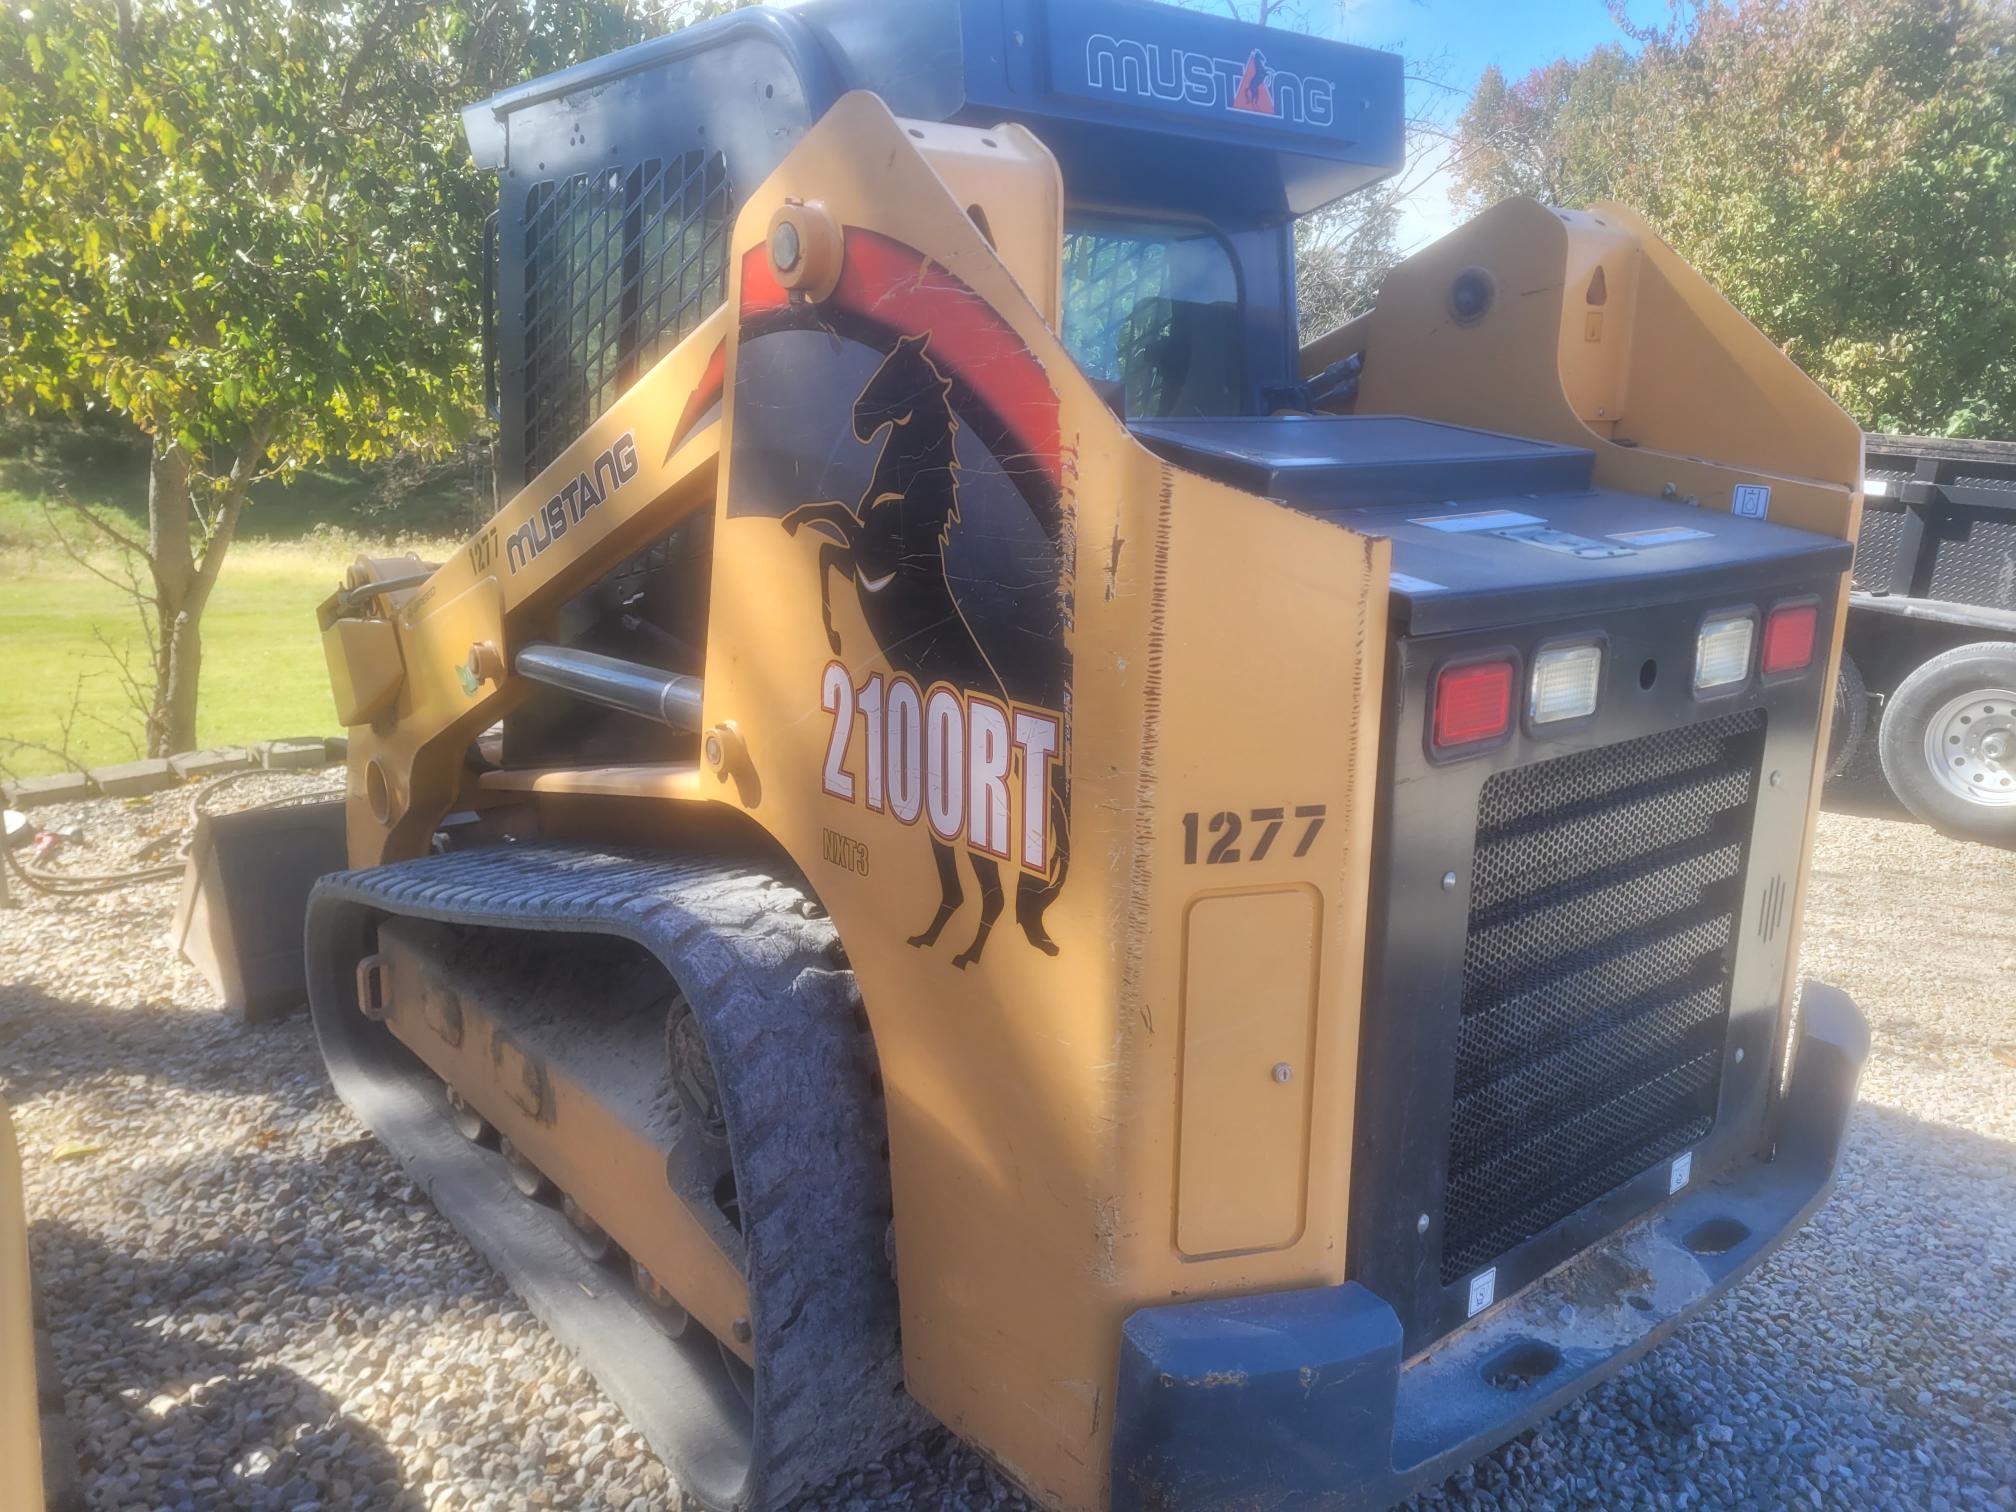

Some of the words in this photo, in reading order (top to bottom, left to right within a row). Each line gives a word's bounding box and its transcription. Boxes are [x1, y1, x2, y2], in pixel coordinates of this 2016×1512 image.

[1086, 34, 1334, 126] MUSTANG
[505, 432, 639, 576] MUSTANG
[468, 527, 499, 576] 1277
[821, 660, 1060, 875] 2100RT
[823, 827, 870, 877] NXT3
[1182, 804, 1327, 865] 1277
